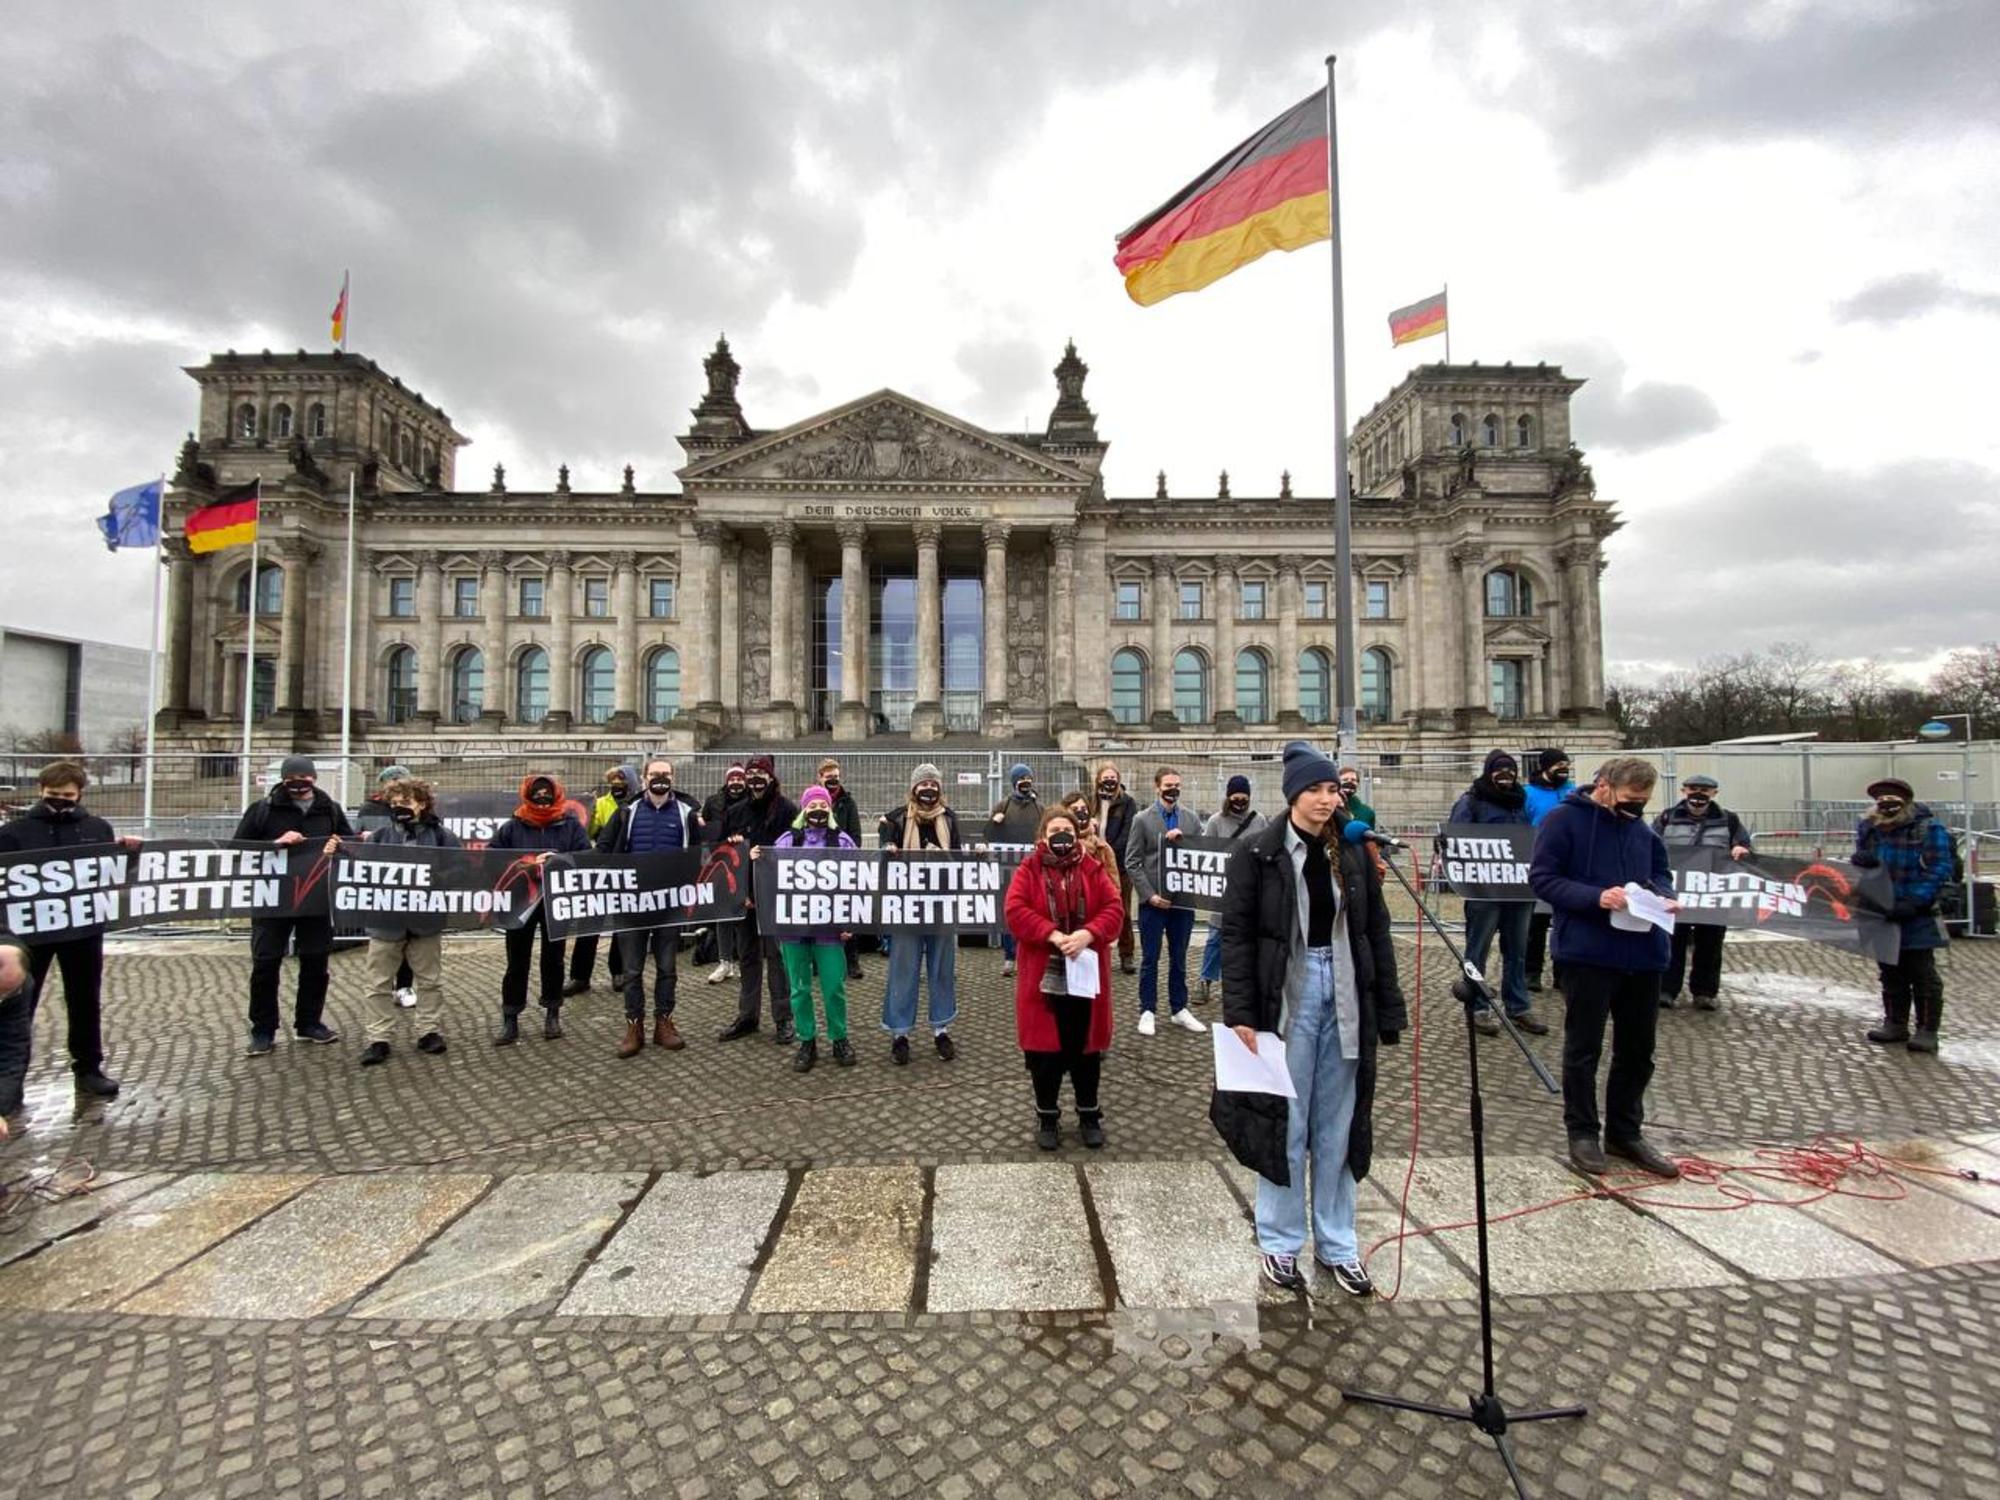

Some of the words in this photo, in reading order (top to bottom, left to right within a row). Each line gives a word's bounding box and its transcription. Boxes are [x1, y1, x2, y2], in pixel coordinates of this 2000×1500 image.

[805, 505, 835, 516] DEM
[846, 505, 921, 517] DEUTSCHEN
[932, 506, 973, 517] VOLKE
[442, 817, 511, 840] UFST
[1165, 848, 1232, 873] LETZT
[1446, 838, 1514, 859] LETZTE
[0, 856, 127, 897] SSEN
[138, 849, 288, 882] RETTEN
[338, 859, 431, 886] LETZTE
[550, 869, 638, 894] LETZTE
[777, 859, 879, 891] ESSEN
[887, 861, 999, 890] RETTEN
[1166, 871, 1227, 897] GENE
[1447, 861, 1531, 884] GENERA
[335, 886, 511, 912] GENERATION
[1685, 871, 1807, 903] RETTEN
[6, 890, 119, 935] EBEN
[129, 879, 279, 917] RETTEN
[552, 882, 714, 921] GENERATION
[775, 894, 872, 924] LEBEN
[881, 895, 996, 924] RETTEN
[1678, 892, 1802, 917] RETTEN
